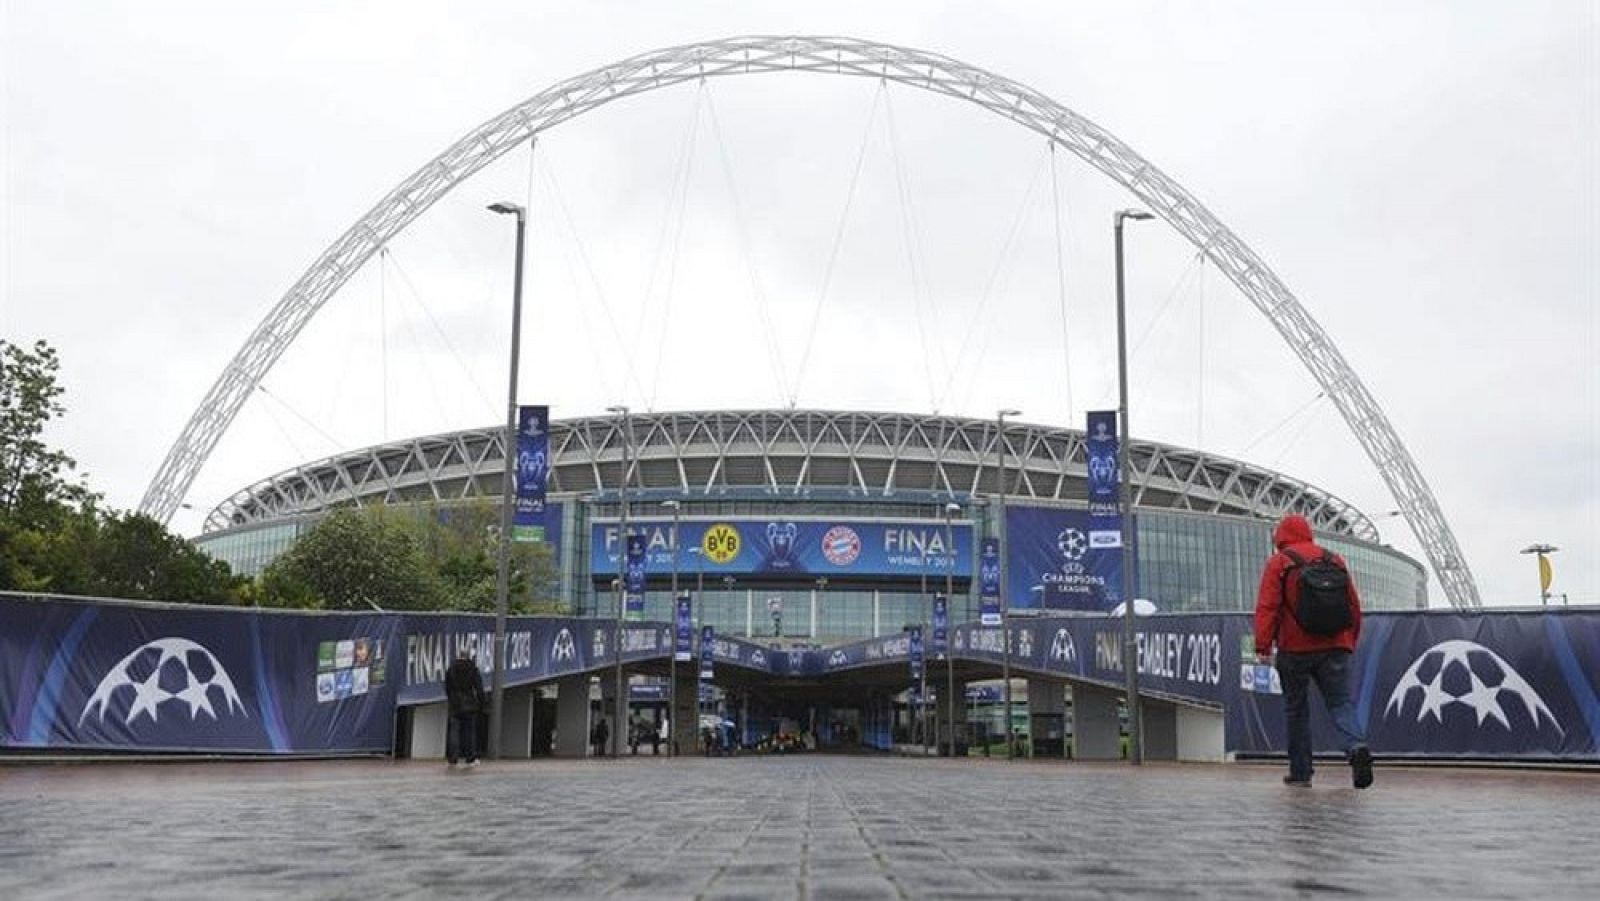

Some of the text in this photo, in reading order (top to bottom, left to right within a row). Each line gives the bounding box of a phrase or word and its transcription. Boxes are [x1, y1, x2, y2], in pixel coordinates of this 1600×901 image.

[708, 529, 737, 551] BVB
[1042, 572, 1104, 586] CHAMPIONS
[1134, 632, 1184, 678] EMBLEY
[1187, 634, 1221, 685] 2013
